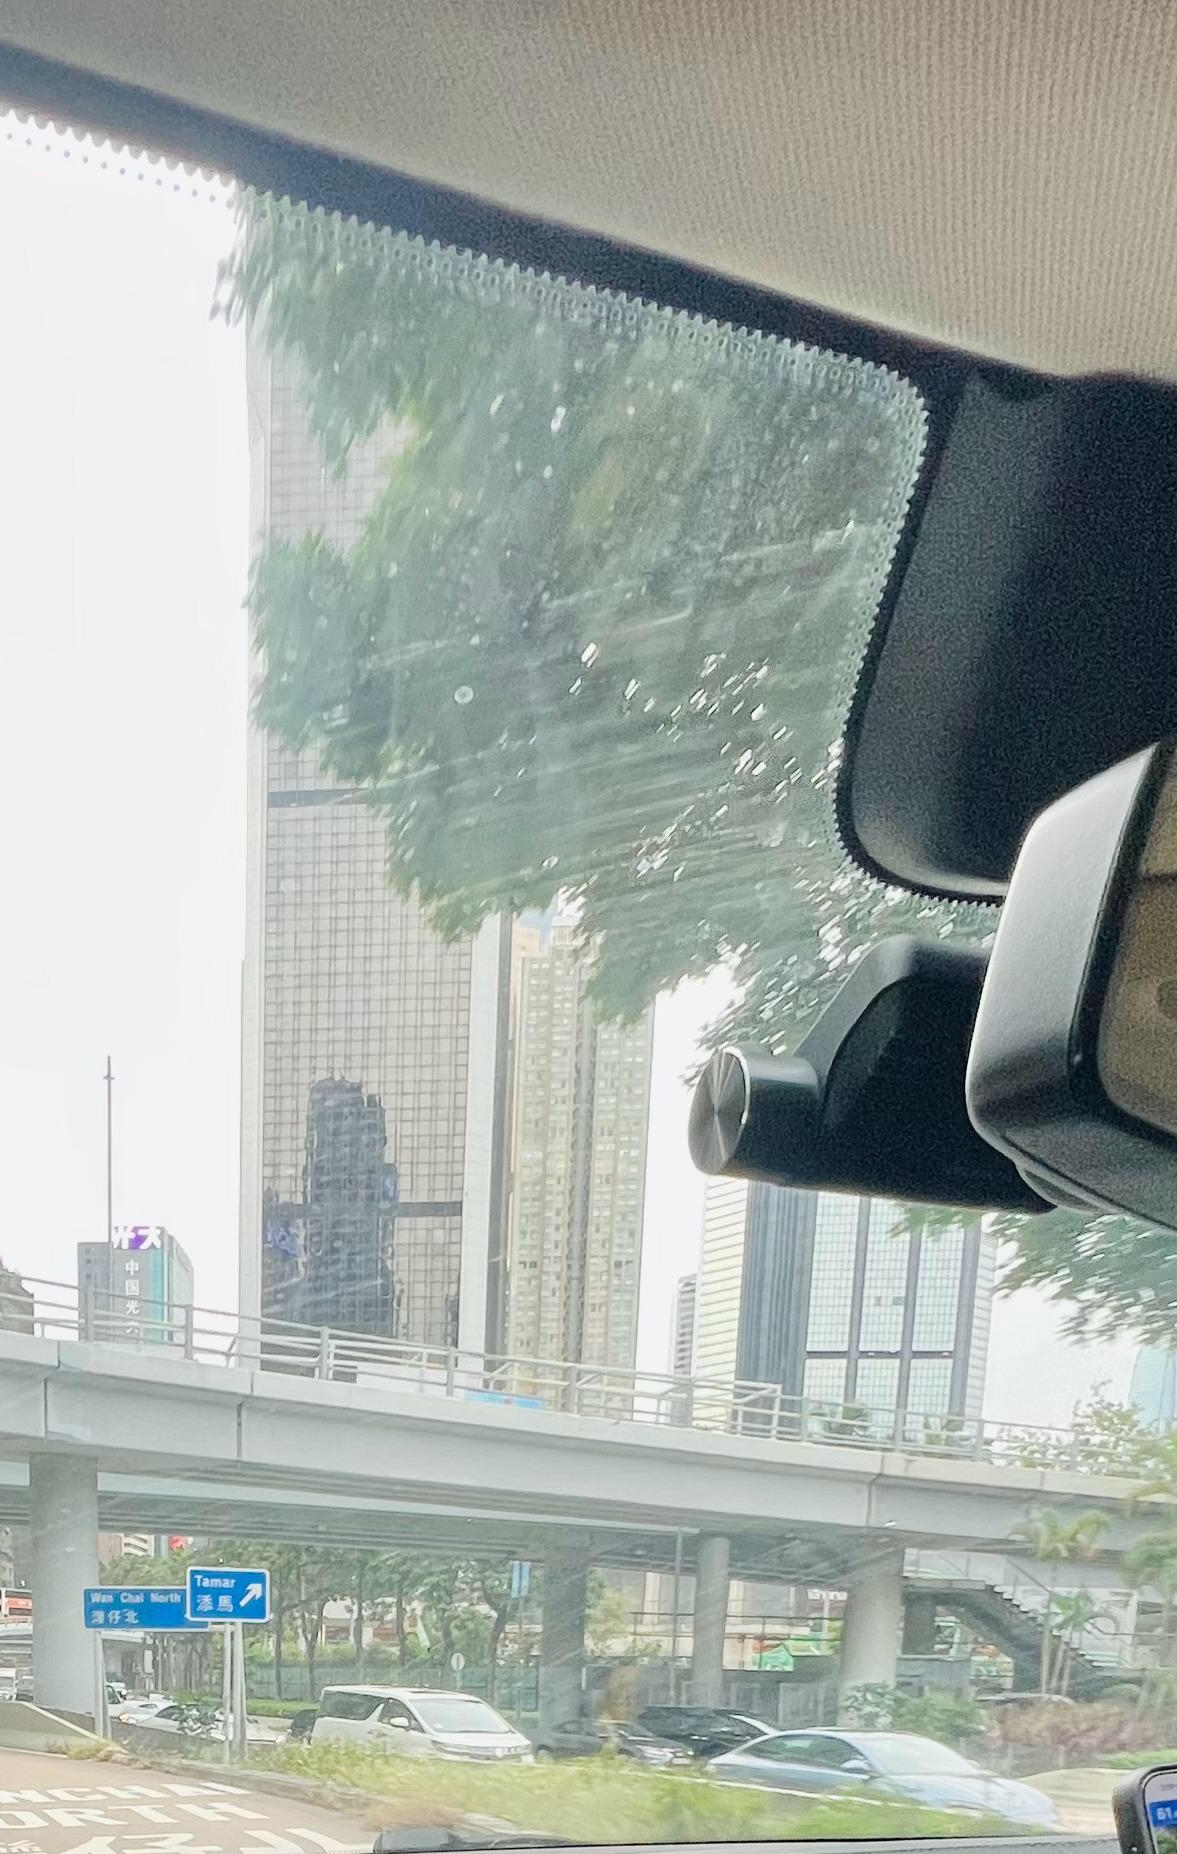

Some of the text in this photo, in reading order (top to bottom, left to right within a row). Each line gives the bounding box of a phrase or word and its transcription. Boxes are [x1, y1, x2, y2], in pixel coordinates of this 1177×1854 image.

[194, 1574, 236, 1588] Tamar
[91, 1592, 181, 1604] Wan Chai North
[196, 1595, 233, 1613] 添馬
[91, 1609, 139, 1625] 灣仔北
